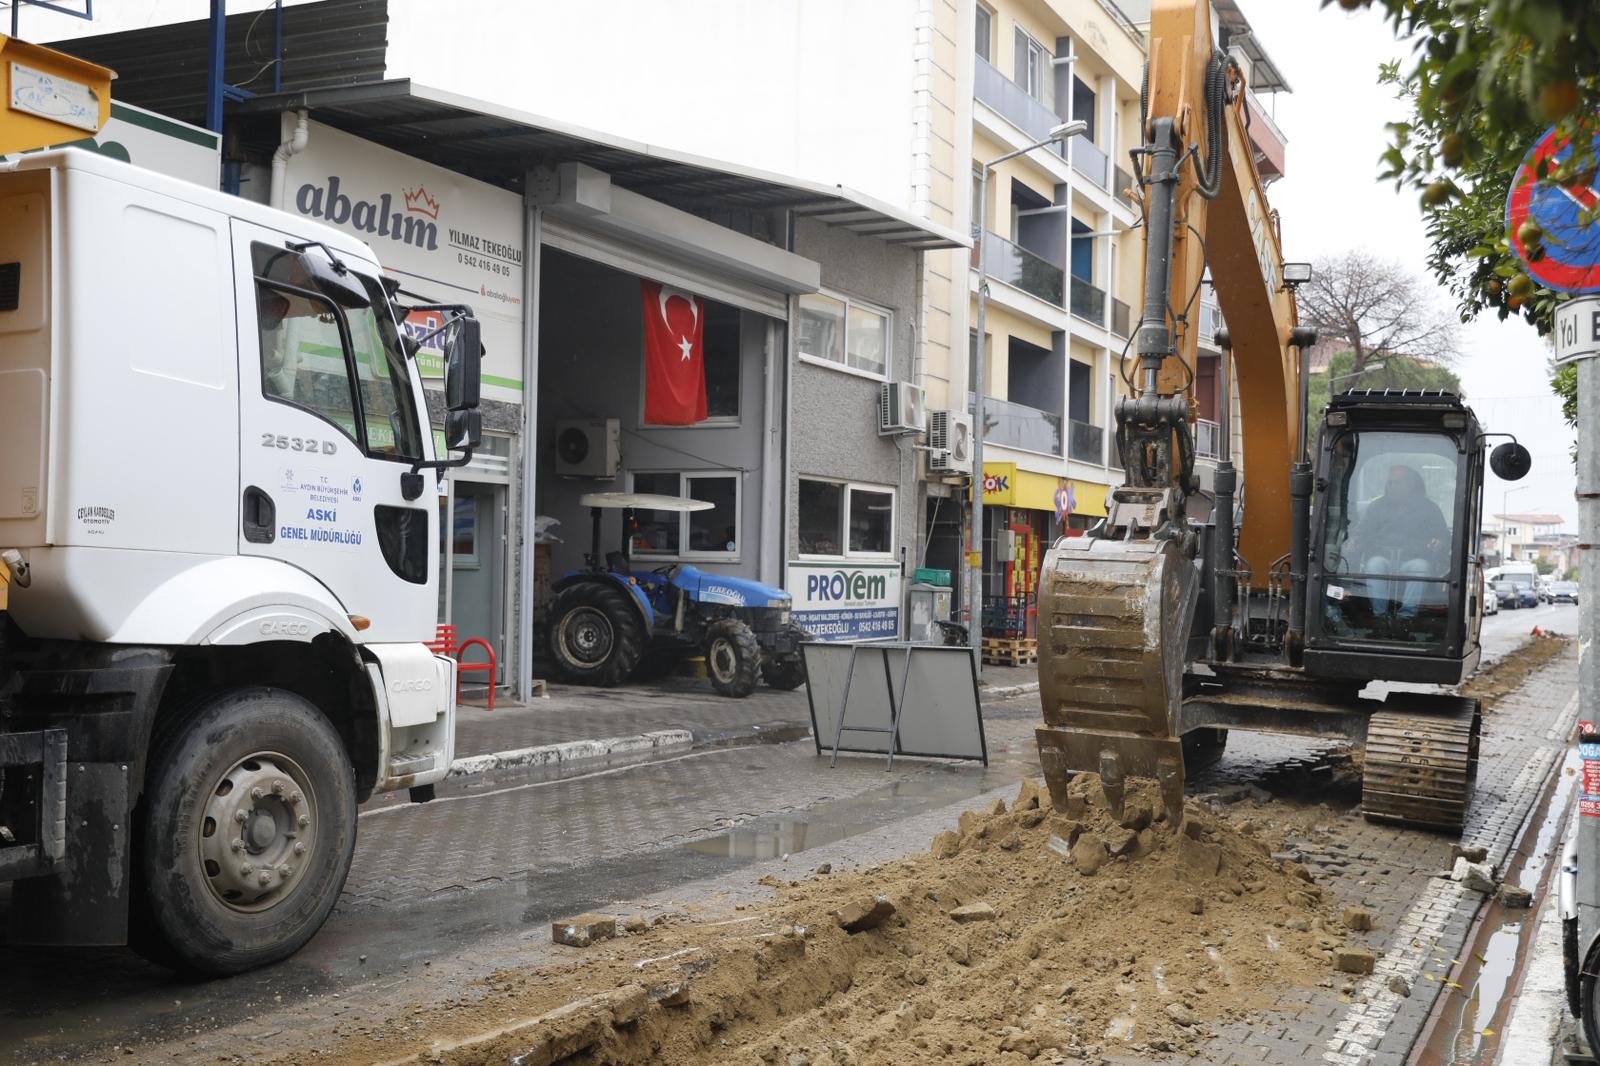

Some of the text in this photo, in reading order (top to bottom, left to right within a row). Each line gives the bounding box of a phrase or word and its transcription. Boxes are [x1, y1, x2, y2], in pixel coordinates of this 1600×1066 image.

[296, 176, 438, 251] abalım
[448, 229, 522, 262] YILMAZ TEKEOĞLU
[458, 252, 511, 277] 0 542 416 49 05
[1560, 313, 1578, 349] Yol
[261, 433, 338, 455] 2532 D
[300, 484, 316, 492] AYDIN
[982, 472, 1009, 495] OK
[306, 508, 338, 522] ASKİ
[280, 526, 362, 545] GENEL MÜDÜRLÜĞÜ
[807, 570, 886, 601] PROYem
[259, 620, 310, 637] CARGO
[391, 679, 433, 692] CARGO
